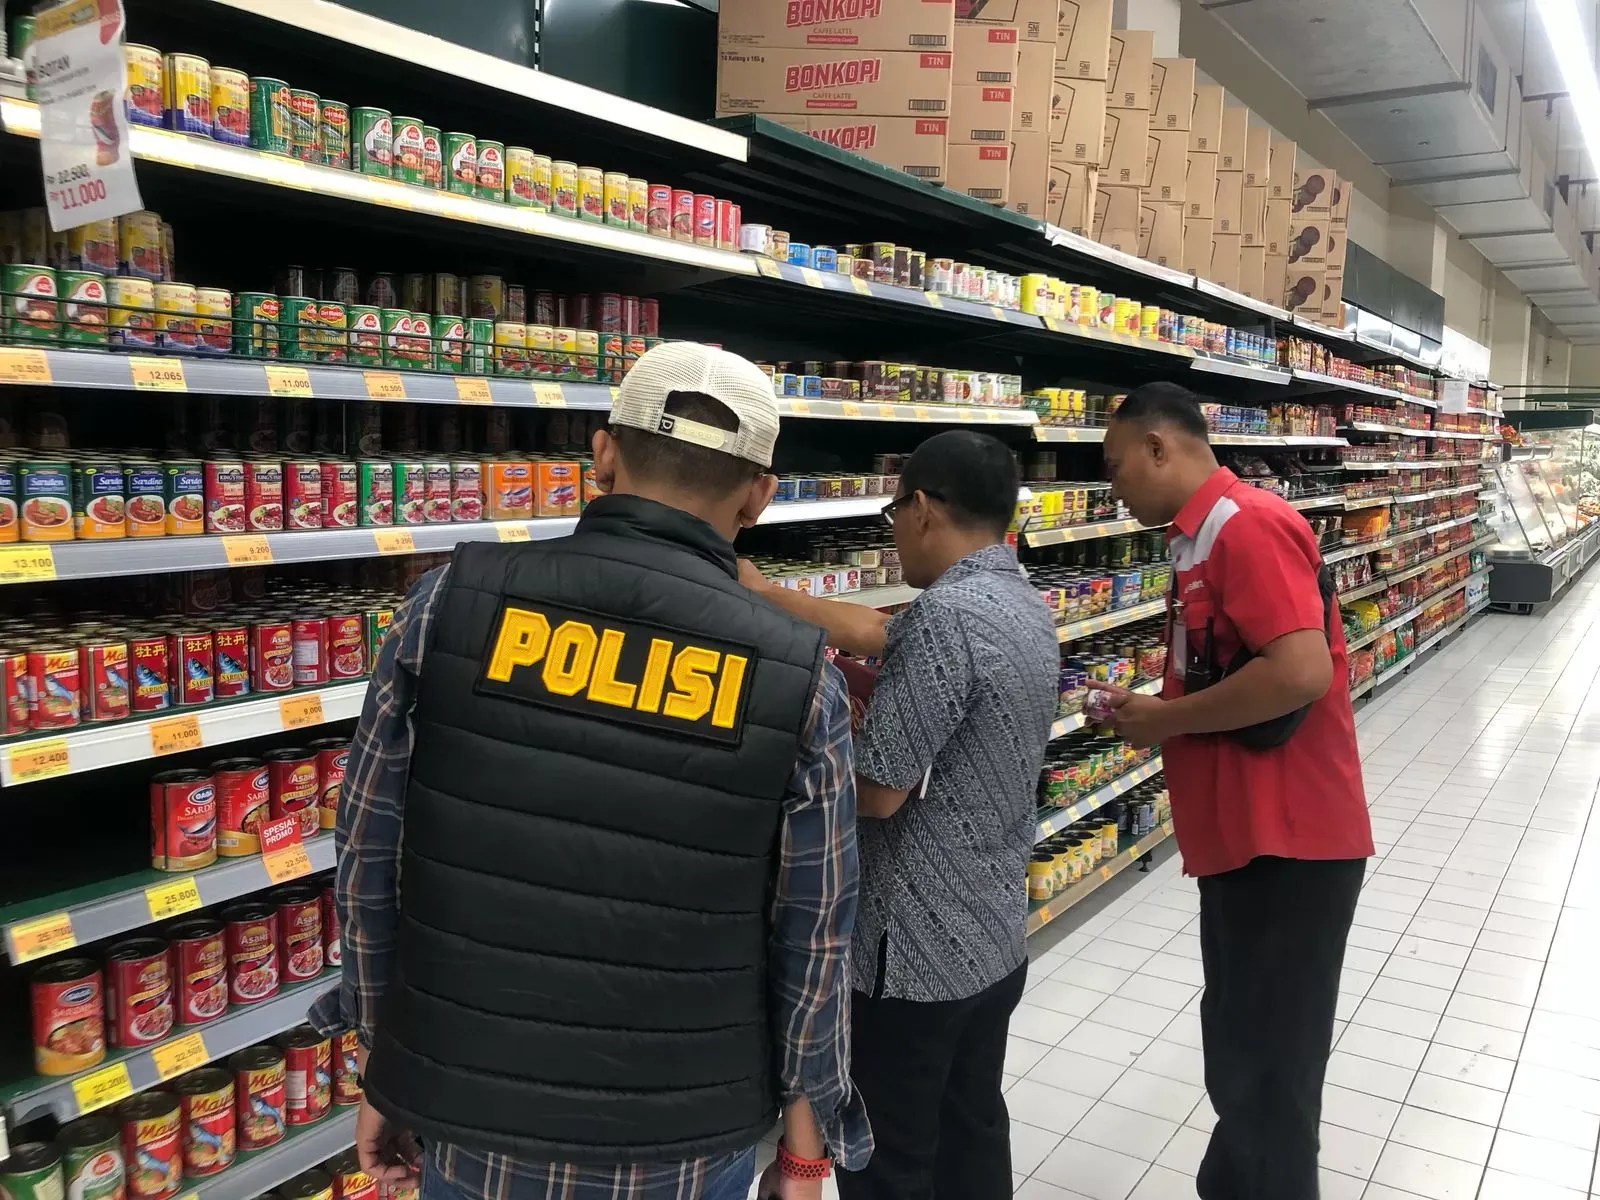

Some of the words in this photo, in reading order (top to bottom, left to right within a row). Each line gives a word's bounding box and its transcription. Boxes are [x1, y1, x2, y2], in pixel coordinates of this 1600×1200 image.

[996, 32, 1010, 40] TIN
[928, 56, 944, 66] TIN
[785, 58, 881, 92] BONKOPI
[989, 91, 1004, 99] TIN
[923, 122, 940, 132] TIN
[987, 150, 1002, 158] TIN
[60, 178, 106, 210] 11.000
[150, 370, 182, 380] 12.065
[282, 380, 310, 388] 11.000
[250, 546, 270, 554] 9.200
[13, 558, 52, 568] 13.100
[217, 634, 245, 646] 牡丹
[135, 644, 165, 658] 牡丹
[487, 607, 748, 729] POLISI
[304, 705, 322, 715] 9.000
[173, 728, 198, 740] 11.000
[264, 818, 297, 838] SPESIAL
[266, 827, 293, 847] PROMO
[285, 855, 308, 868] 22.500
[164, 888, 197, 905] 25.800
